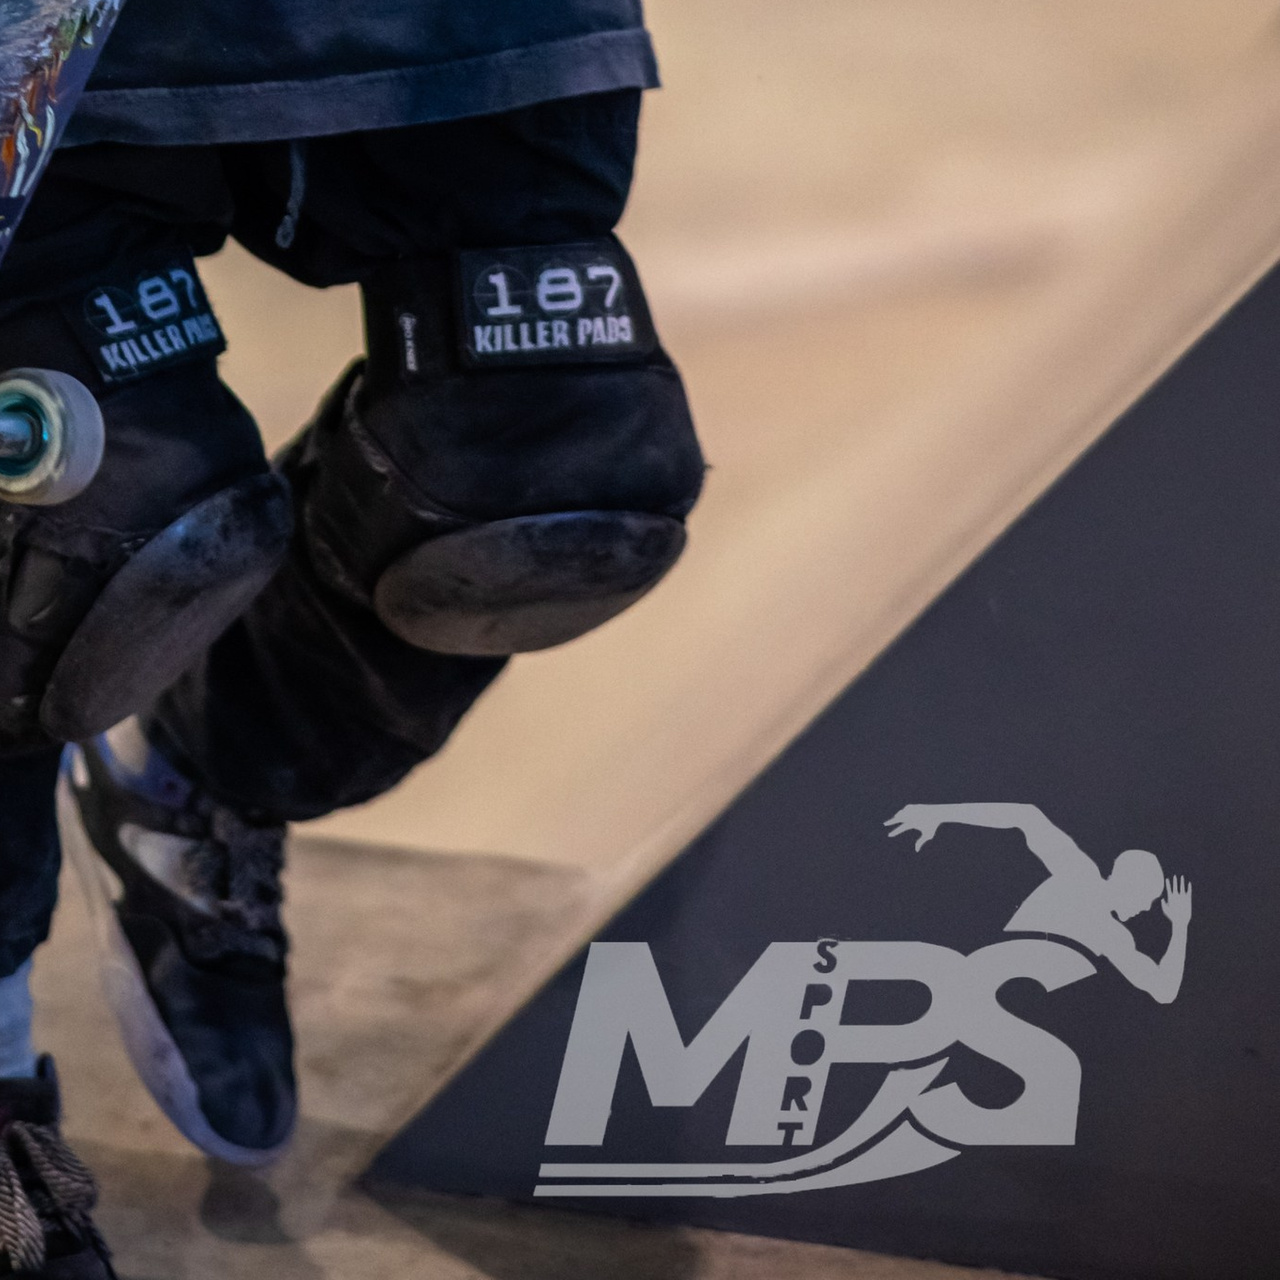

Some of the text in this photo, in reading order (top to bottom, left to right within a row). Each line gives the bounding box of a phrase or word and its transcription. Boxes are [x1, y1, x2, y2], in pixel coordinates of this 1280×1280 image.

[95, 268, 197, 334] 187
[487, 265, 621, 316] 187
[100, 324, 188, 372] KILLER
[474, 315, 632, 352] KILLER PADS
